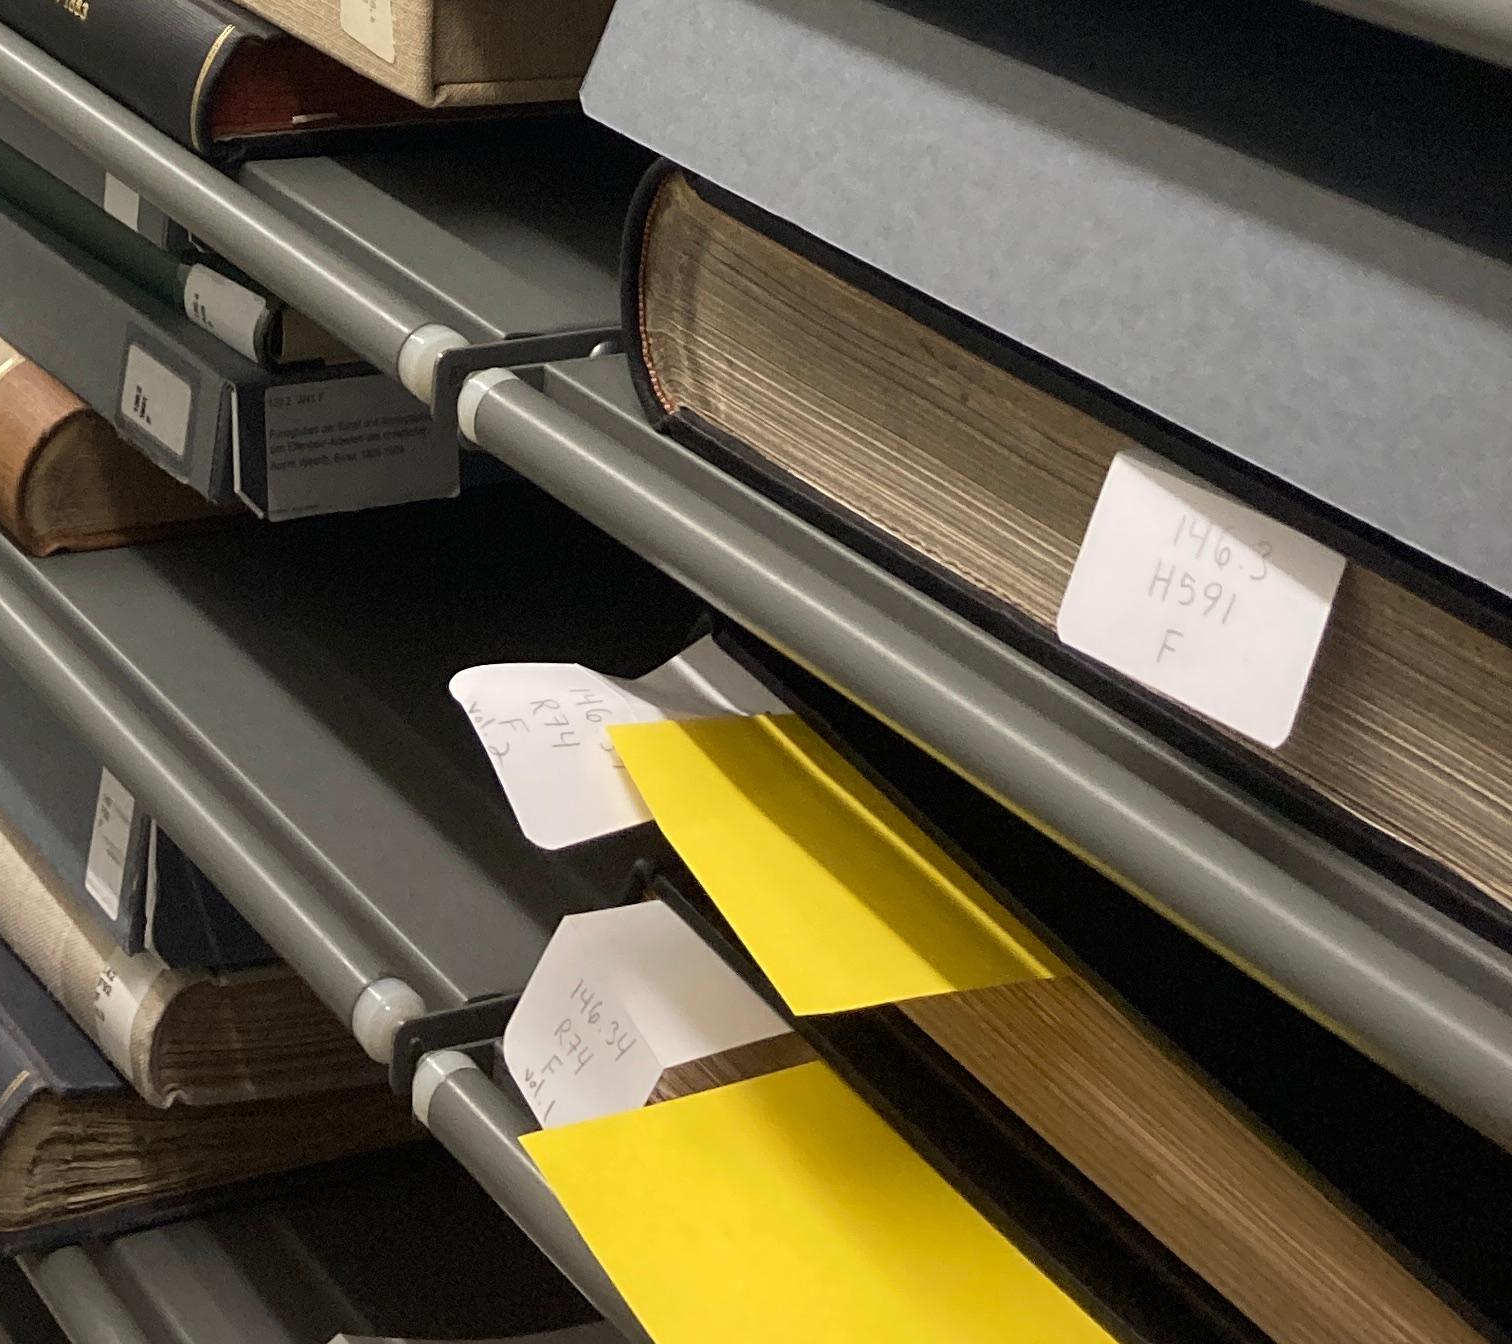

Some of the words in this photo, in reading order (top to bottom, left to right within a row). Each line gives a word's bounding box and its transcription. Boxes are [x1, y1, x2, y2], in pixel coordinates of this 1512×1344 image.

[1146, 559, 1239, 626] H591
[1155, 628, 1184, 665] F
[500, 716, 532, 736] F
[529, 697, 581, 750] R74
[568, 977, 638, 1063] 146.34
[540, 1055, 563, 1075] F
[553, 1017, 595, 1078] R74
